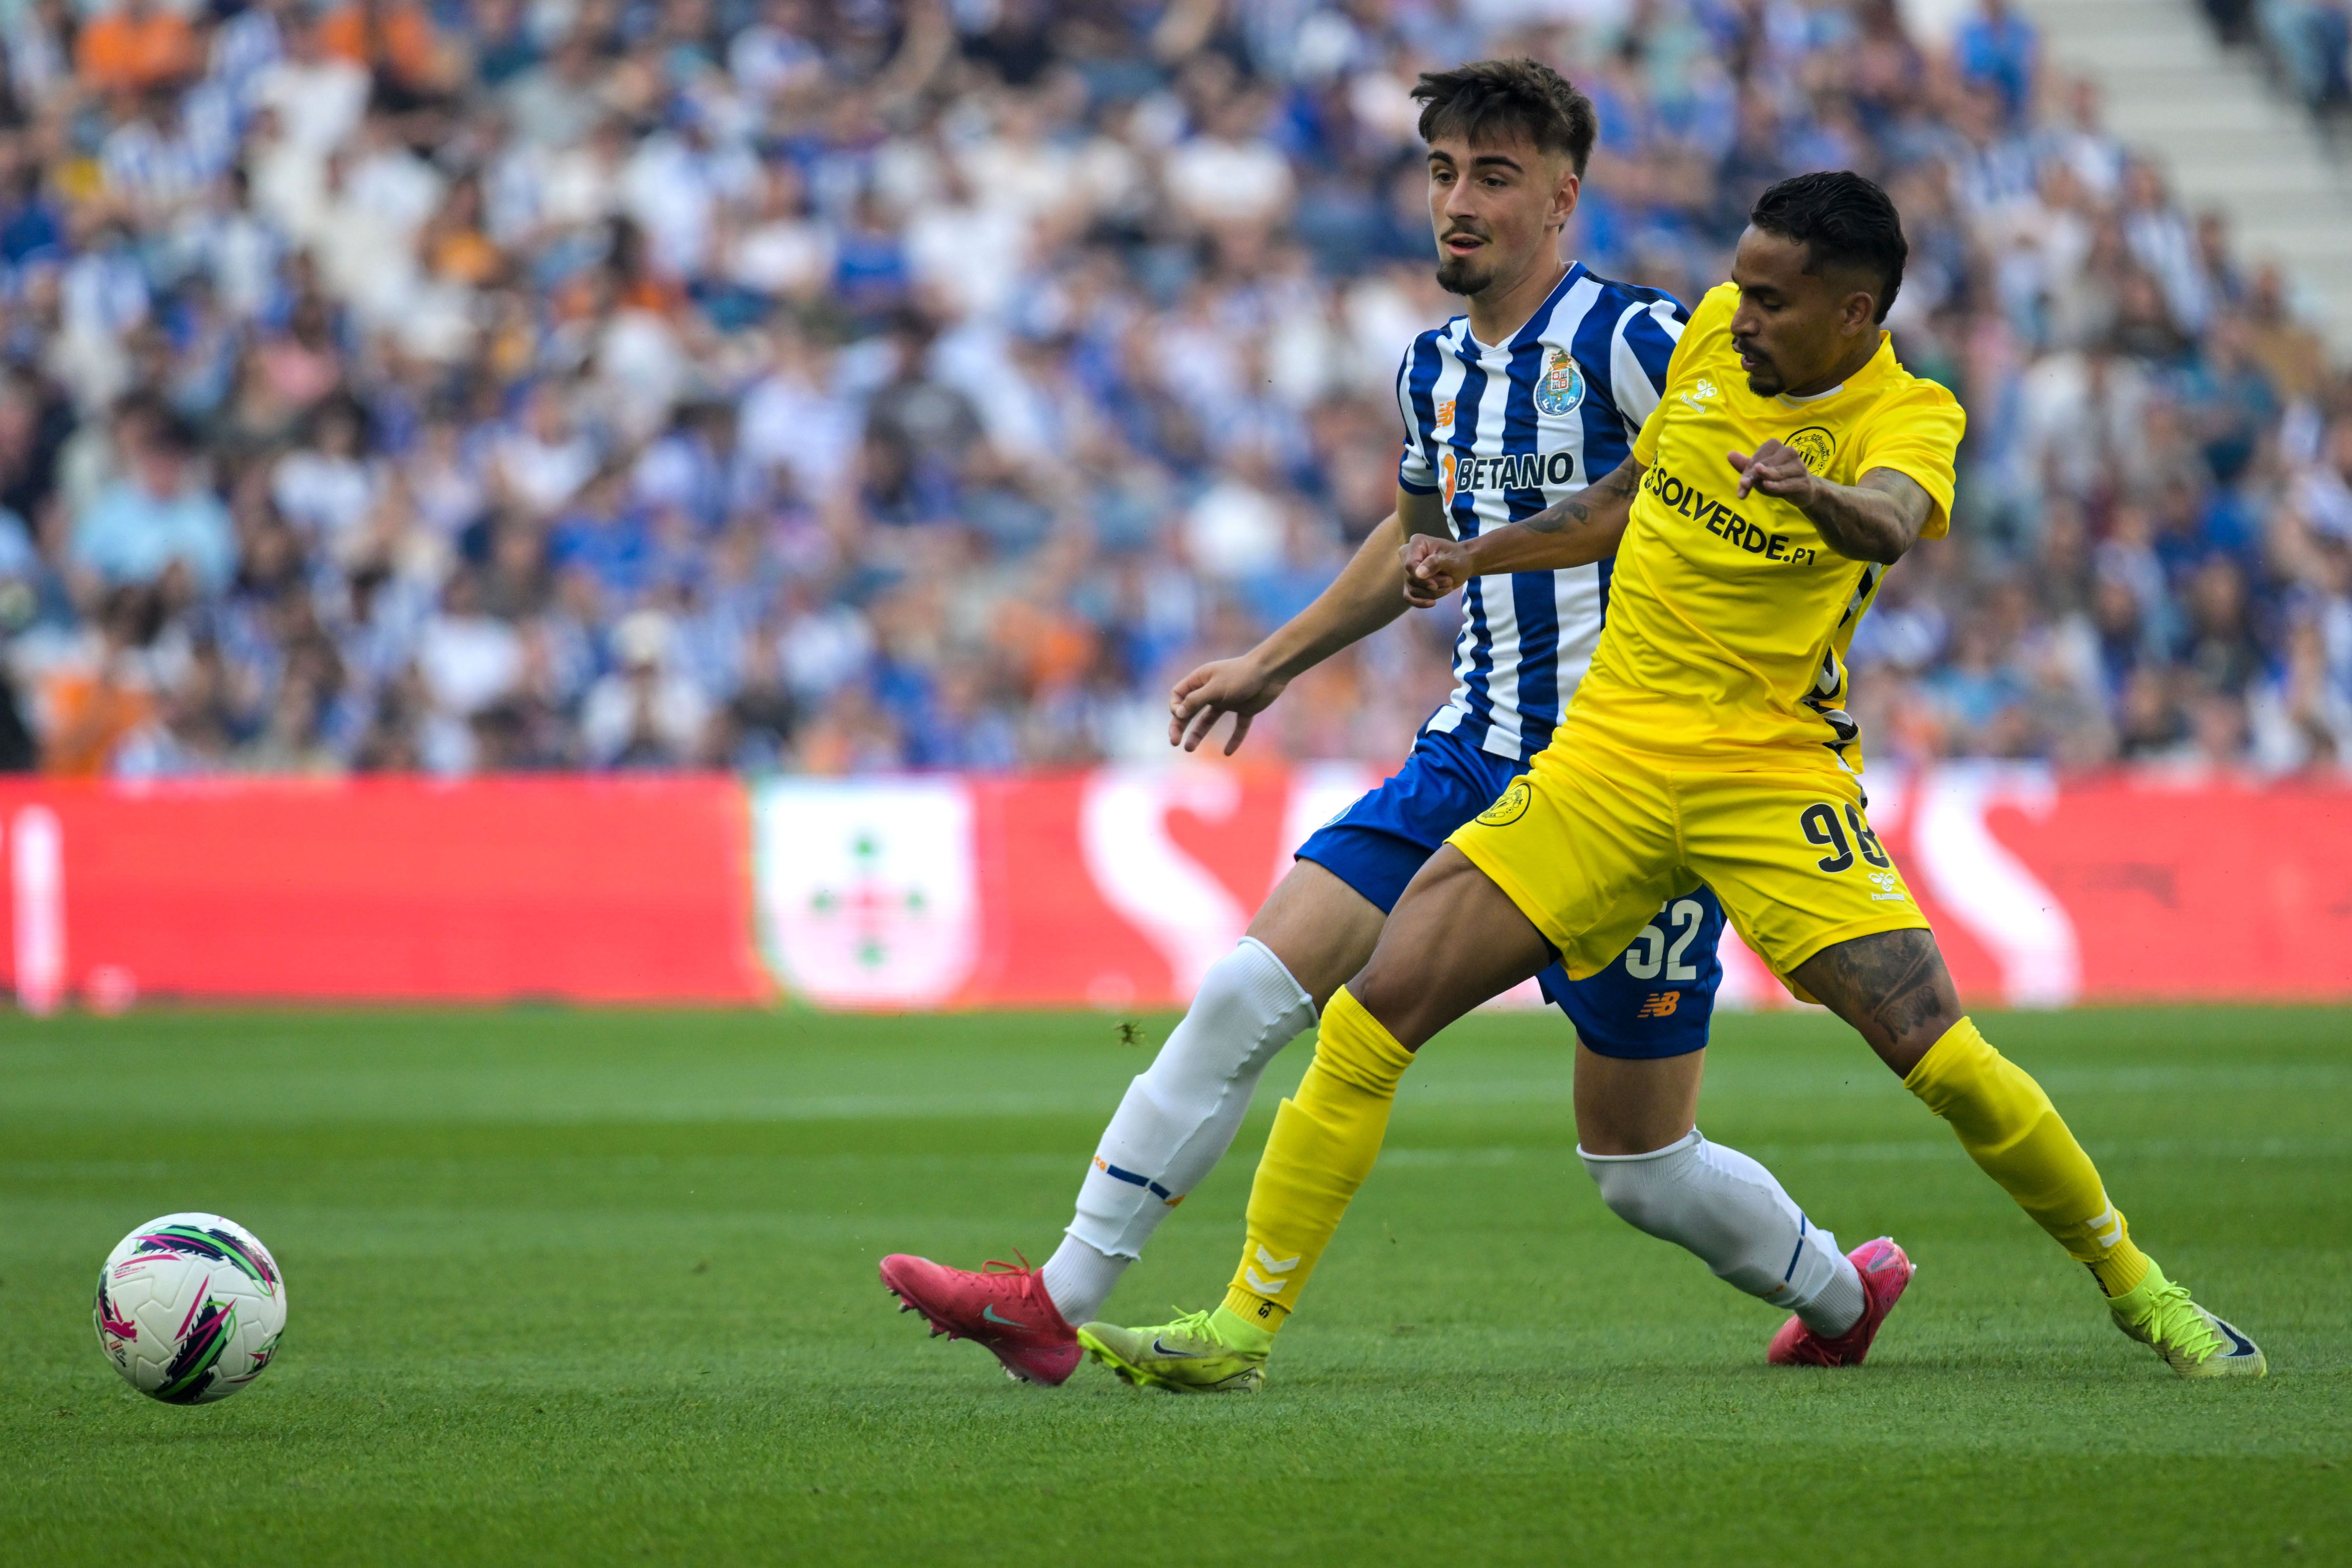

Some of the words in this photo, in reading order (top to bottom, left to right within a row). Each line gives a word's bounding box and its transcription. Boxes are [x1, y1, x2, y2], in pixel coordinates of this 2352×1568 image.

[1679, 391, 1706, 414] hummel
[1811, 437, 1826, 457] NACIONAL
[1456, 452, 1574, 493] BETANO
[1800, 802, 1890, 873] 98
[1871, 892, 1905, 901] hummel
[1625, 899, 1704, 980] 52
